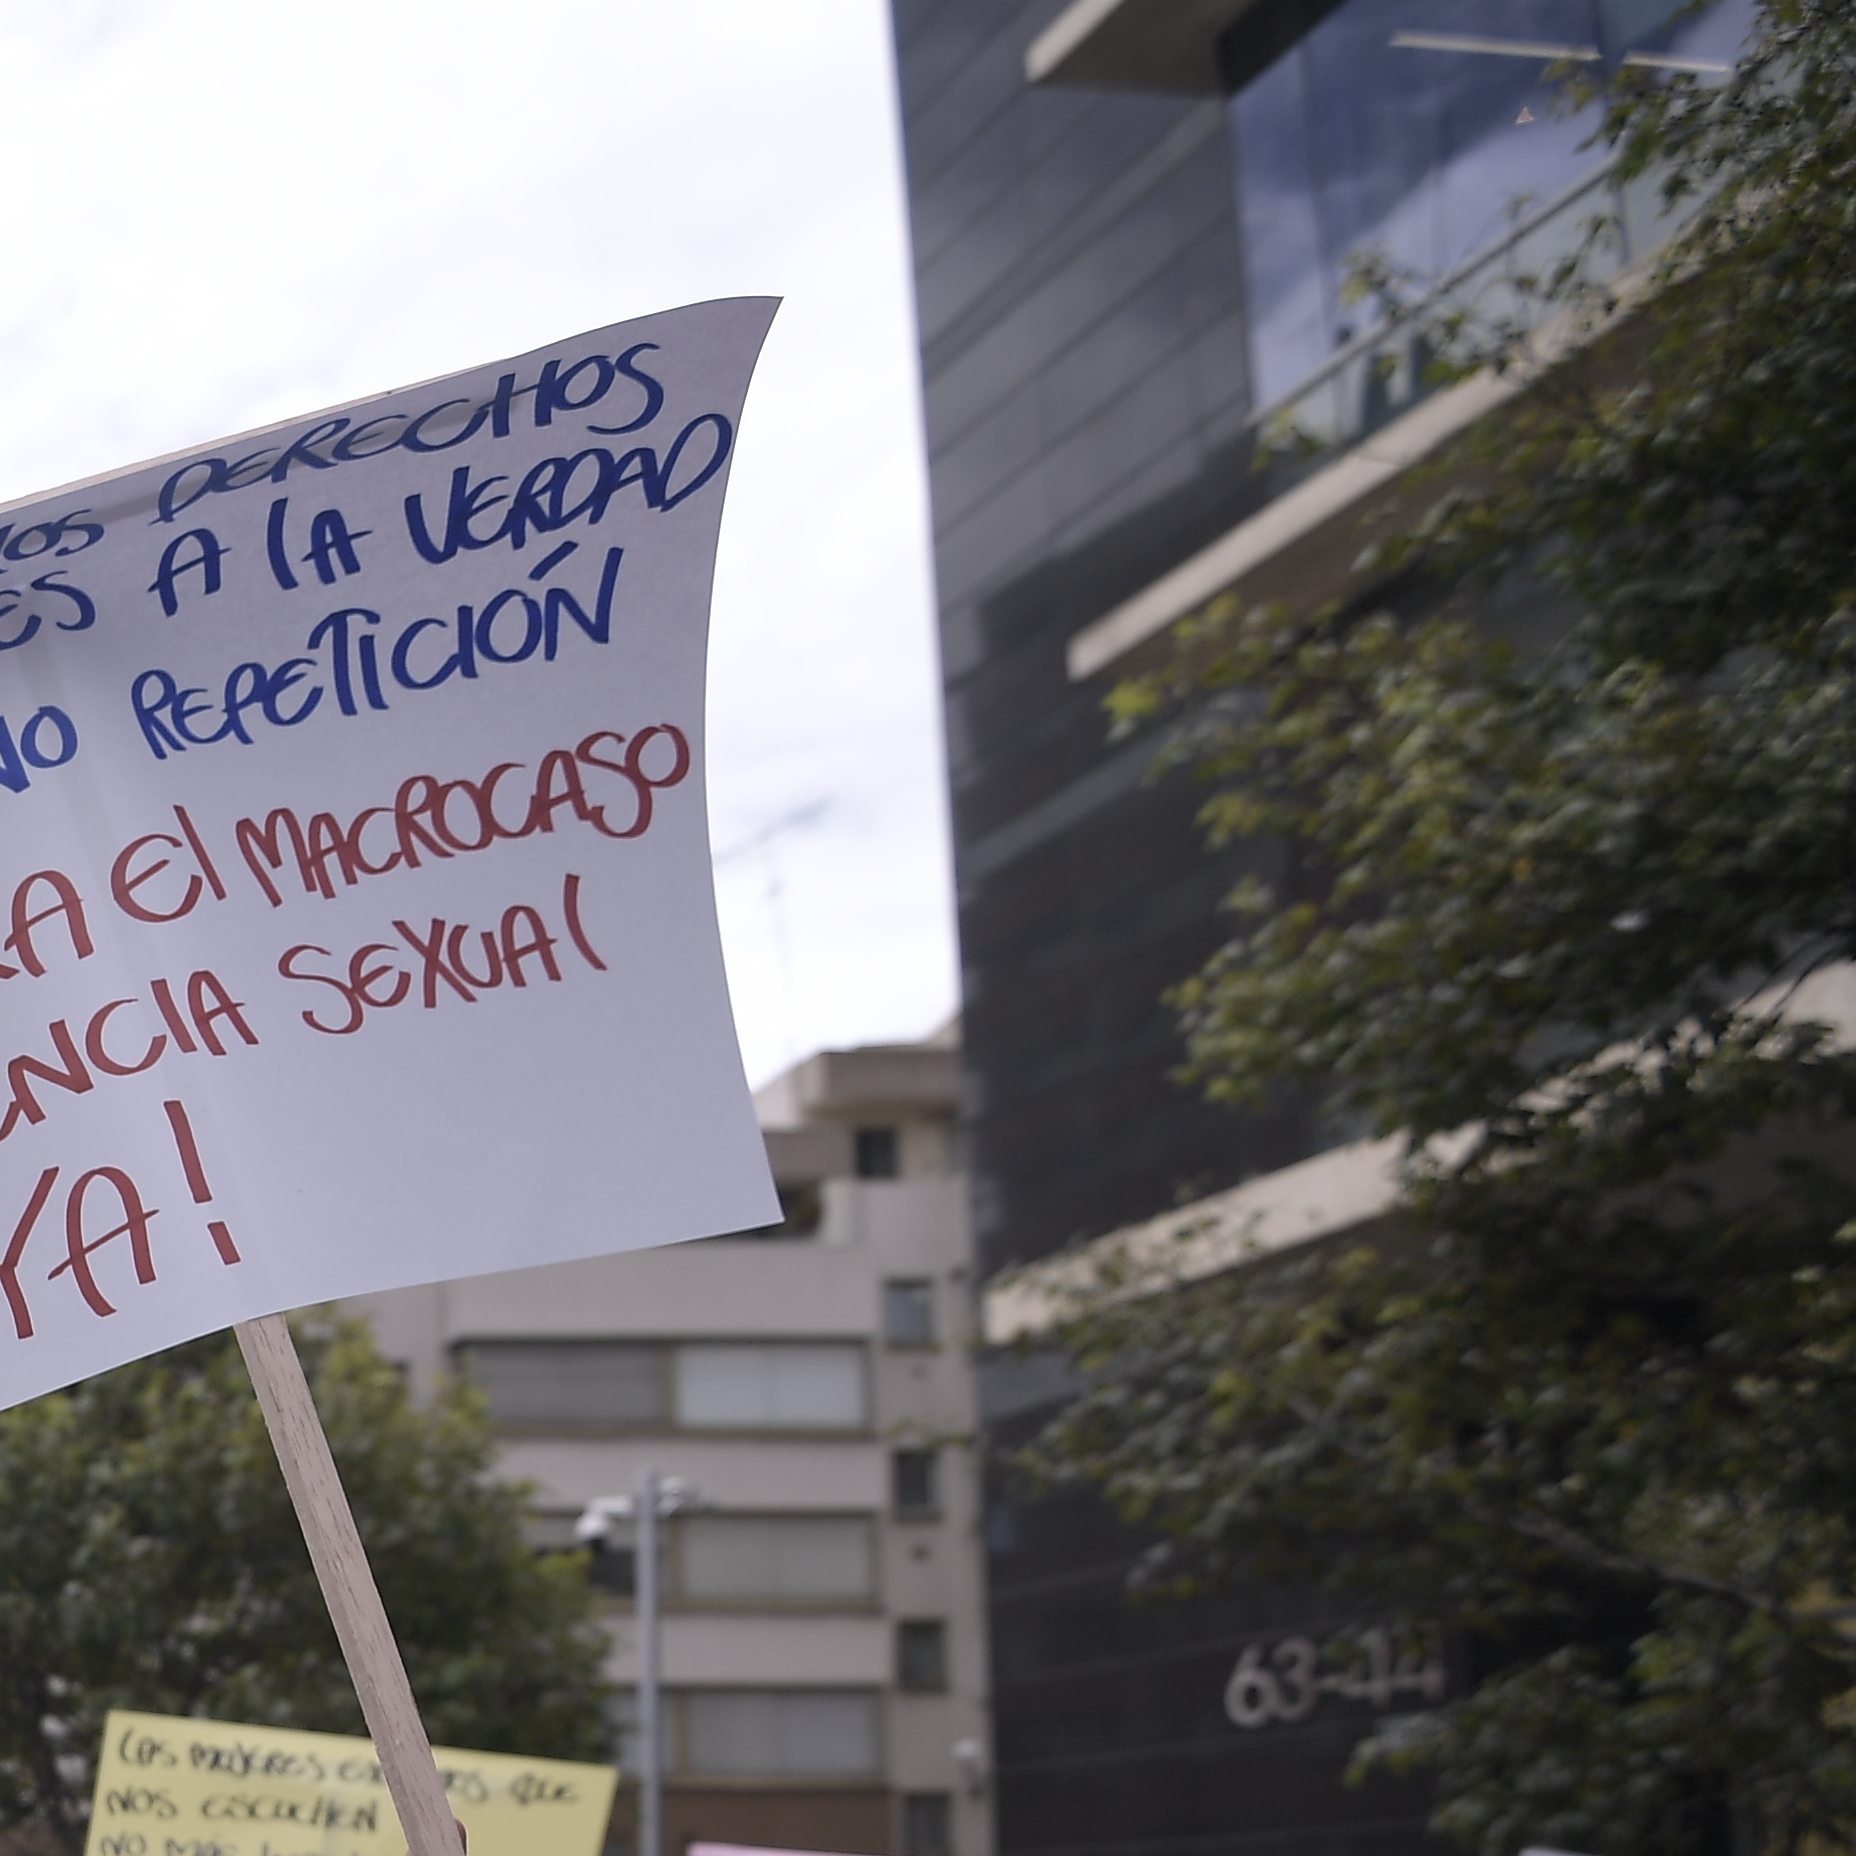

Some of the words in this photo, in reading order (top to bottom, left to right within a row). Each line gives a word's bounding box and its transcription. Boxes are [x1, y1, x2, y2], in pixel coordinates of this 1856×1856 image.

[148, 529, 229, 616] A
[404, 412, 734, 565] VERDAD
[154, 341, 667, 525] DERECHOS
[129, 540, 623, 762] REPETICIÓN
[234, 722, 690, 908] MACROCASO
[106, 1791, 178, 1819] NOS
